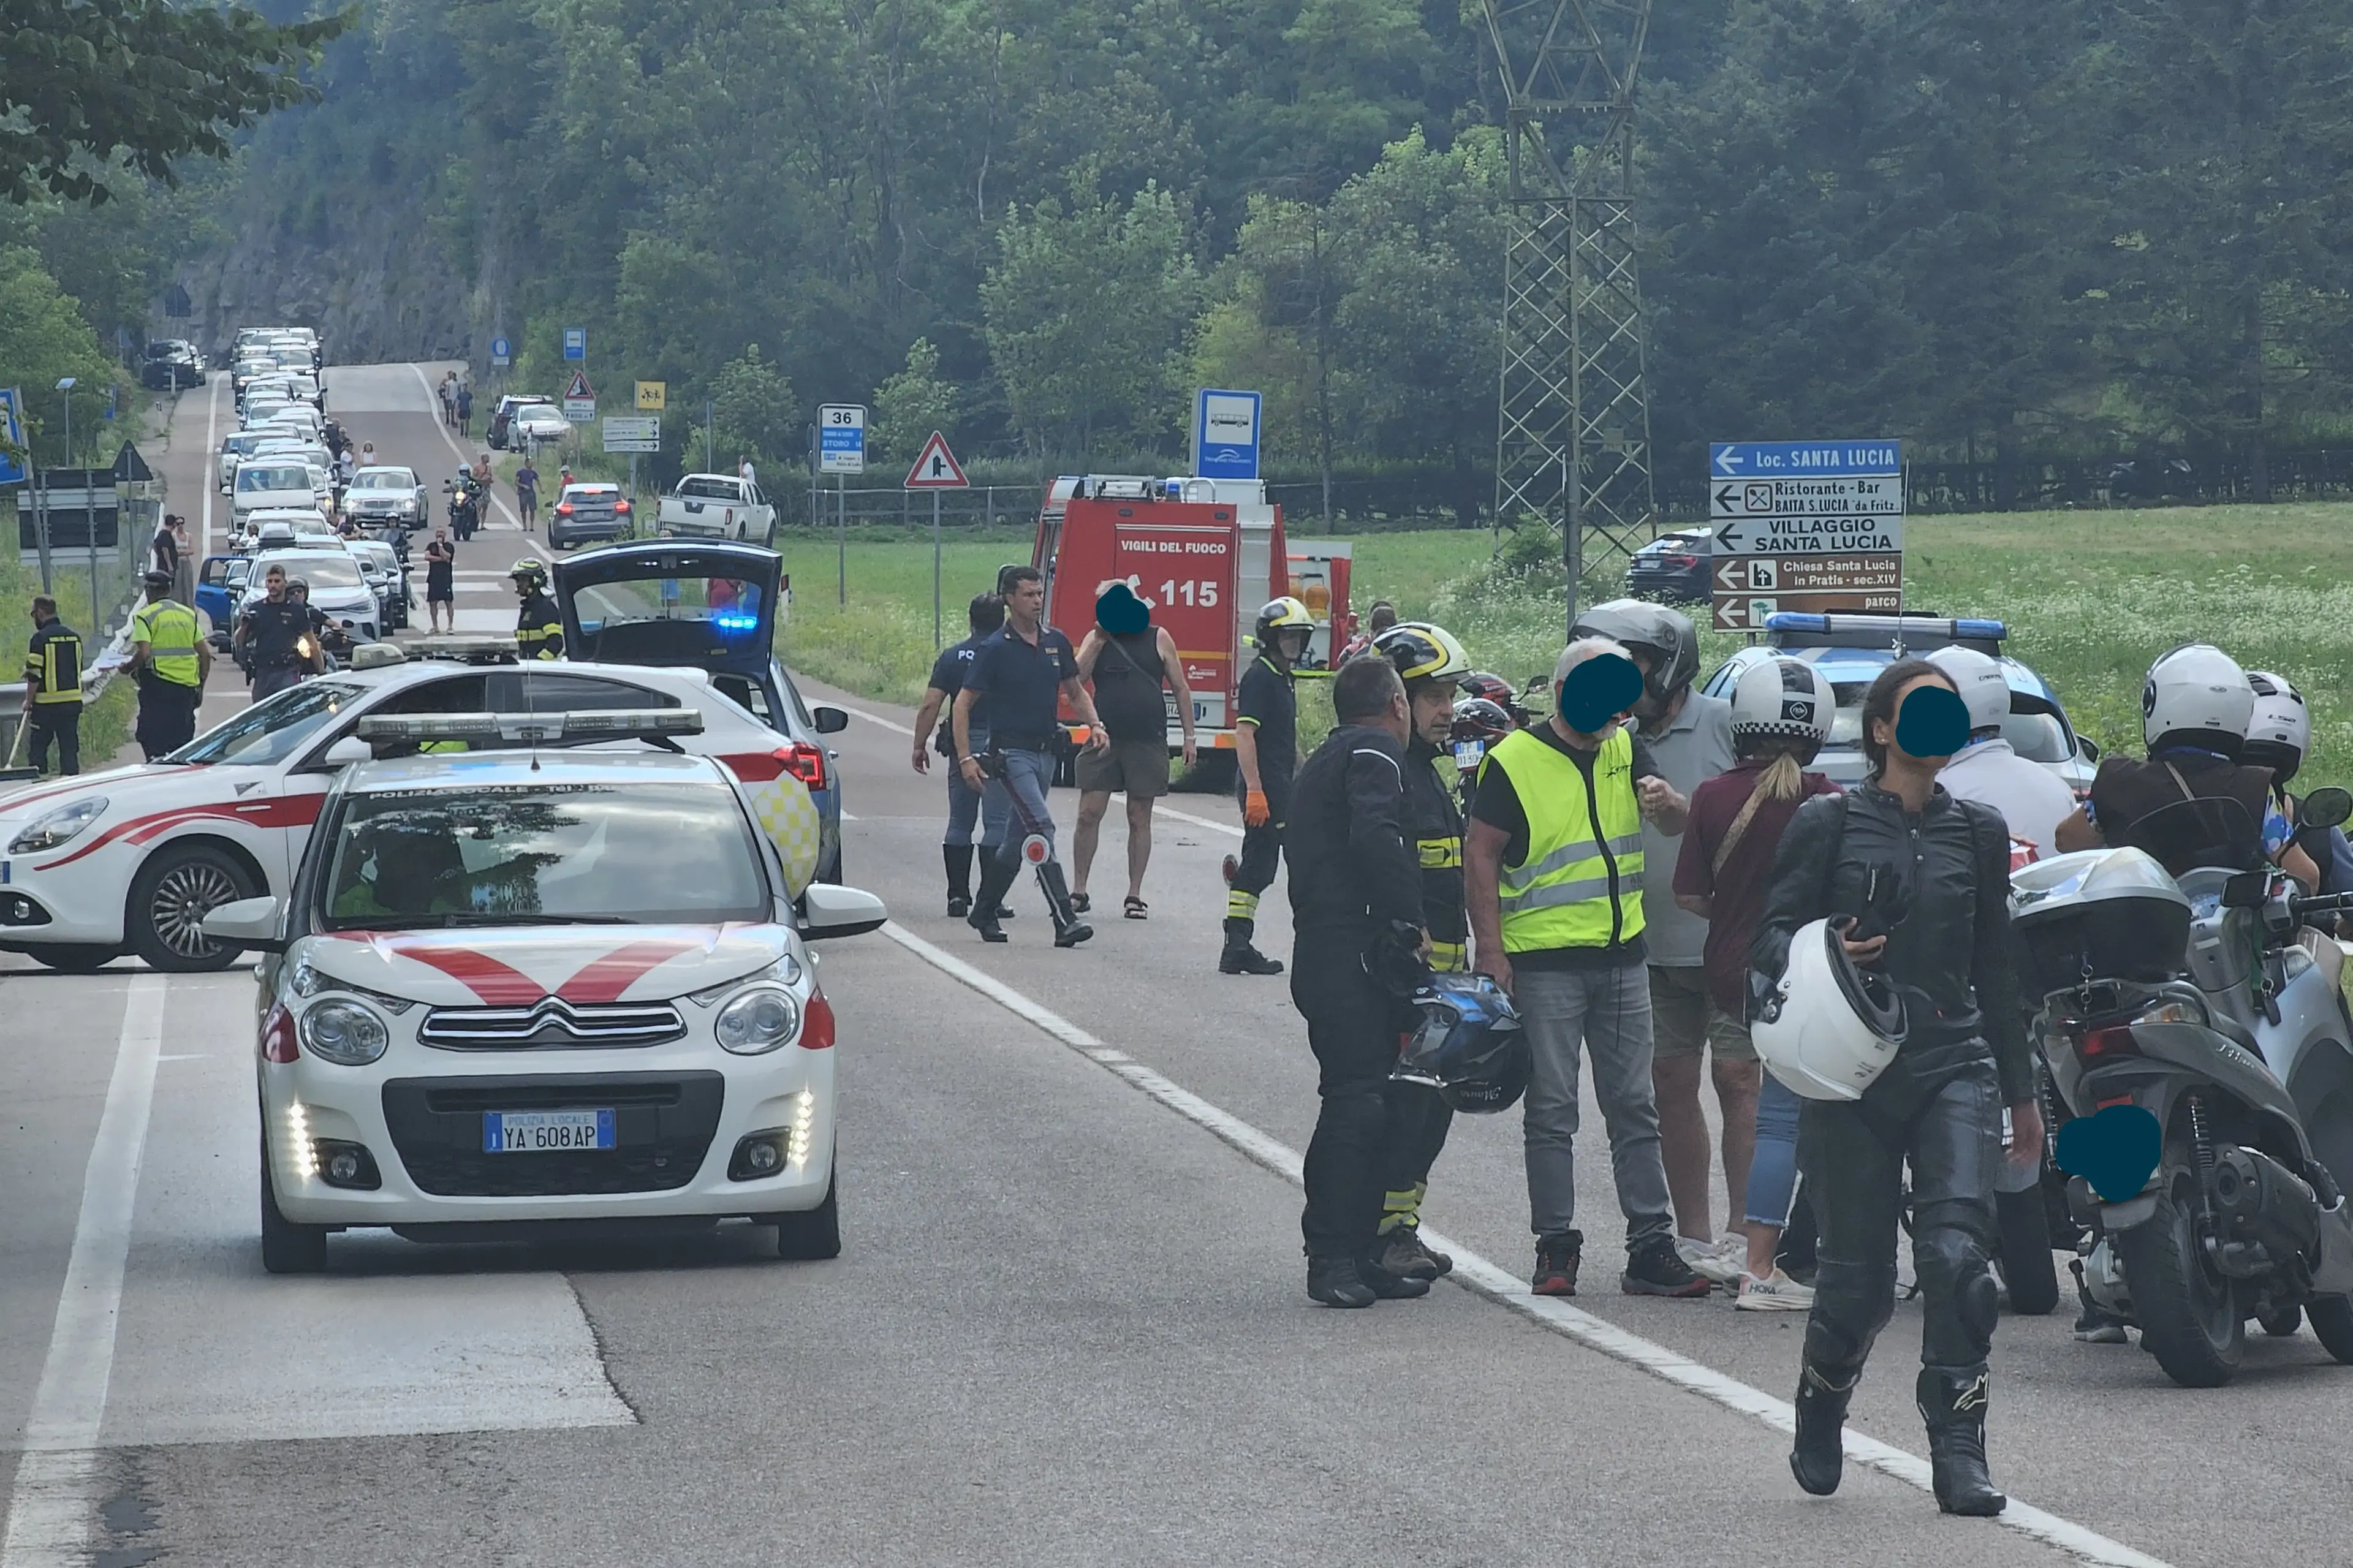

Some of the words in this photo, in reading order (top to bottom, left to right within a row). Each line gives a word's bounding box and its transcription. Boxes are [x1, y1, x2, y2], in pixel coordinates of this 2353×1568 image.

[833, 412, 852, 424] 36
[1756, 452, 1786, 468] Loc.
[1791, 450, 1840, 468] SANTA
[1848, 449, 1895, 466] LUCIA
[1775, 482, 1845, 495] Ristorante
[1858, 480, 1880, 494] Bar
[1775, 499, 1805, 512] BAITA
[1768, 519, 1876, 534] VILLAGGIO
[1121, 540, 1156, 551] VIGILI
[1159, 542, 1182, 553] DEL
[1186, 543, 1226, 554] FUOCO
[1755, 537, 1822, 551] SANTA
[1831, 535, 1892, 549] LUCIA
[1783, 561, 1823, 572] Chiesa
[1827, 560, 1861, 571] Santa
[1865, 559, 1895, 570] Lucia
[1794, 575, 1805, 585] in
[1809, 574, 1843, 585] Pratis
[1161, 580, 1218, 607] 115
[1865, 597, 1897, 609] parco
[369, 787, 449, 800] POLIZIA
[452, 786, 528, 795] LOCALE
[508, 1116, 545, 1126] POLIZIA
[552, 1115, 589, 1125] LOCALE
[504, 1127, 526, 1149] YA
[1749, 1284, 1776, 1295] HOKA
